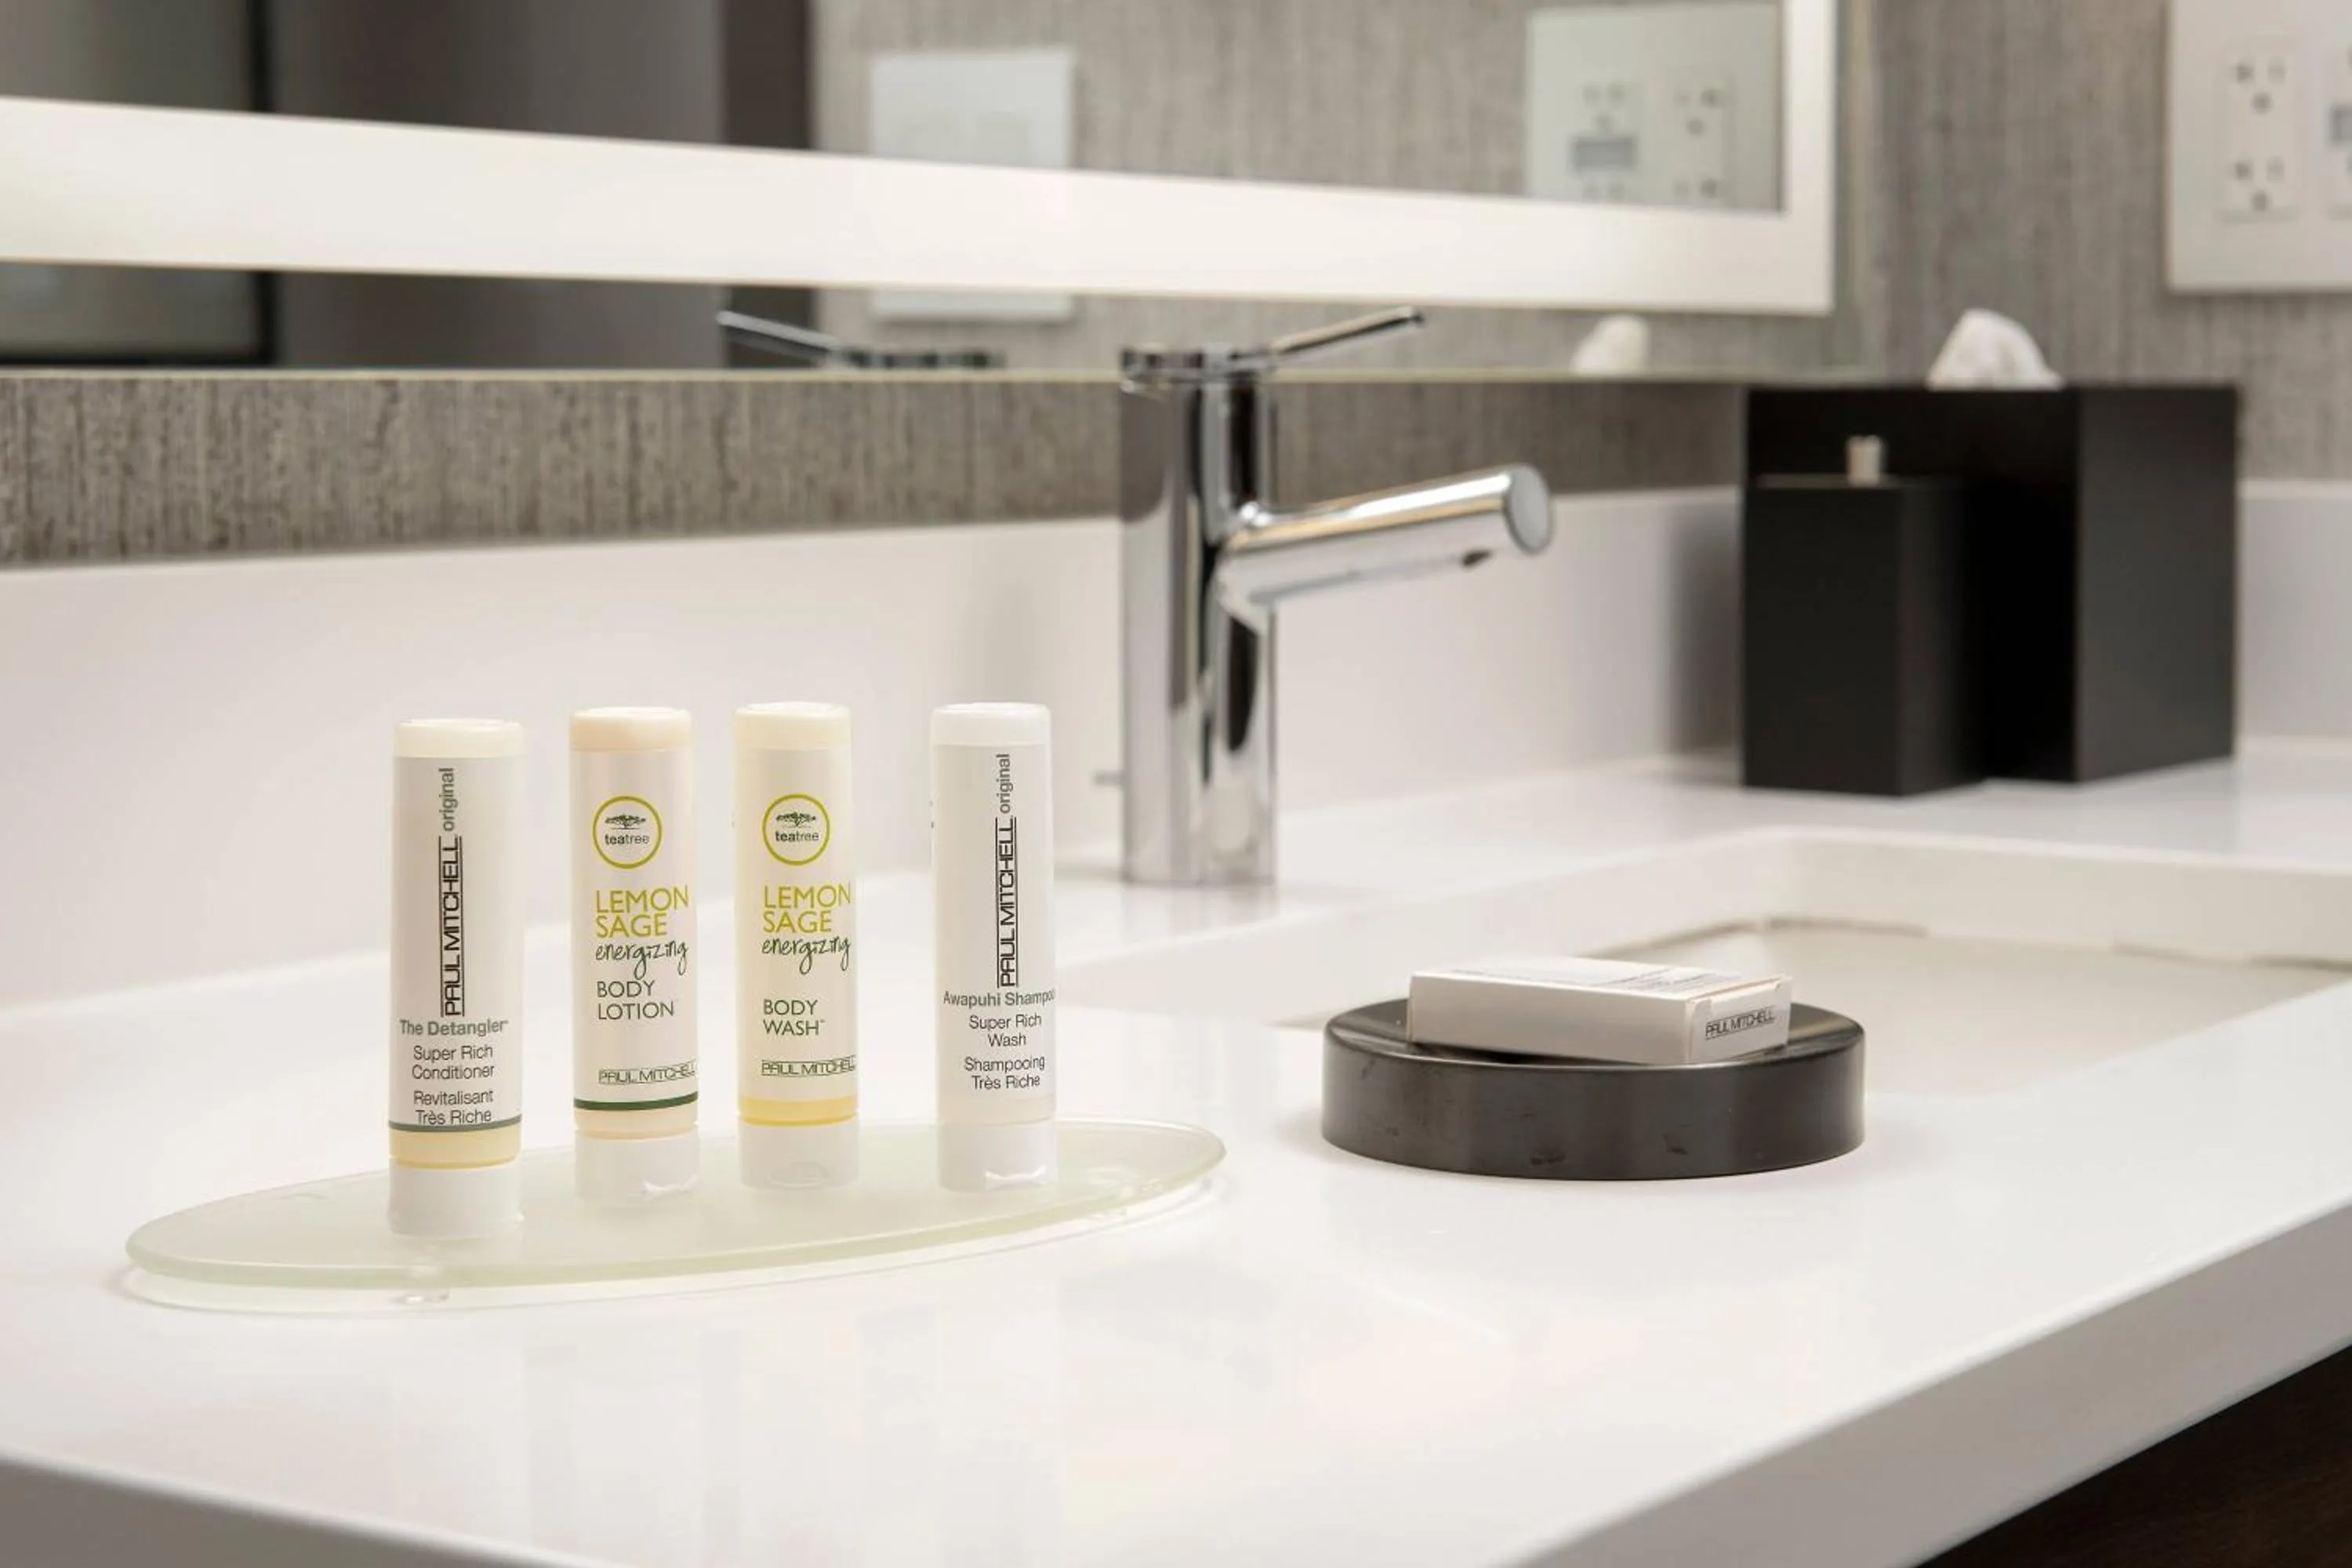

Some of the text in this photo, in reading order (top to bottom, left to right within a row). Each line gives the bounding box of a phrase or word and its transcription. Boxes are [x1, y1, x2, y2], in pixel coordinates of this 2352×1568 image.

[604, 833, 650, 845] teatree
[775, 831, 819, 842] teatree
[996, 753, 1015, 988] PAUL MITCHELL original
[438, 768, 461, 1017] PAUL MITCHELL original
[596, 884, 689, 913] LEMON
[764, 882, 851, 909] LEMON
[595, 913, 668, 938] SAGE
[763, 909, 833, 934] SAGE
[595, 940, 688, 981] energizing
[761, 936, 851, 975] energizing
[597, 980, 655, 997] BODY
[764, 1000, 818, 1015] BODY
[943, 991, 1001, 1008] Awapuhi
[598, 1001, 674, 1020] LOTION
[400, 1019, 423, 1035] The
[968, 1012, 1042, 1031] Super Rich
[987, 1033, 1026, 1047] Wash
[413, 1044, 493, 1063] Super Rich
[412, 1063, 495, 1080] Conditioner
[761, 1061, 798, 1075] PAUL
[964, 1055, 1045, 1073] Shampooing
[598, 1069, 636, 1084] PAUL
[971, 1074, 1041, 1090] Très Riche
[413, 1090, 493, 1105] Revitalisant
[416, 1109, 492, 1125] Très Riche
